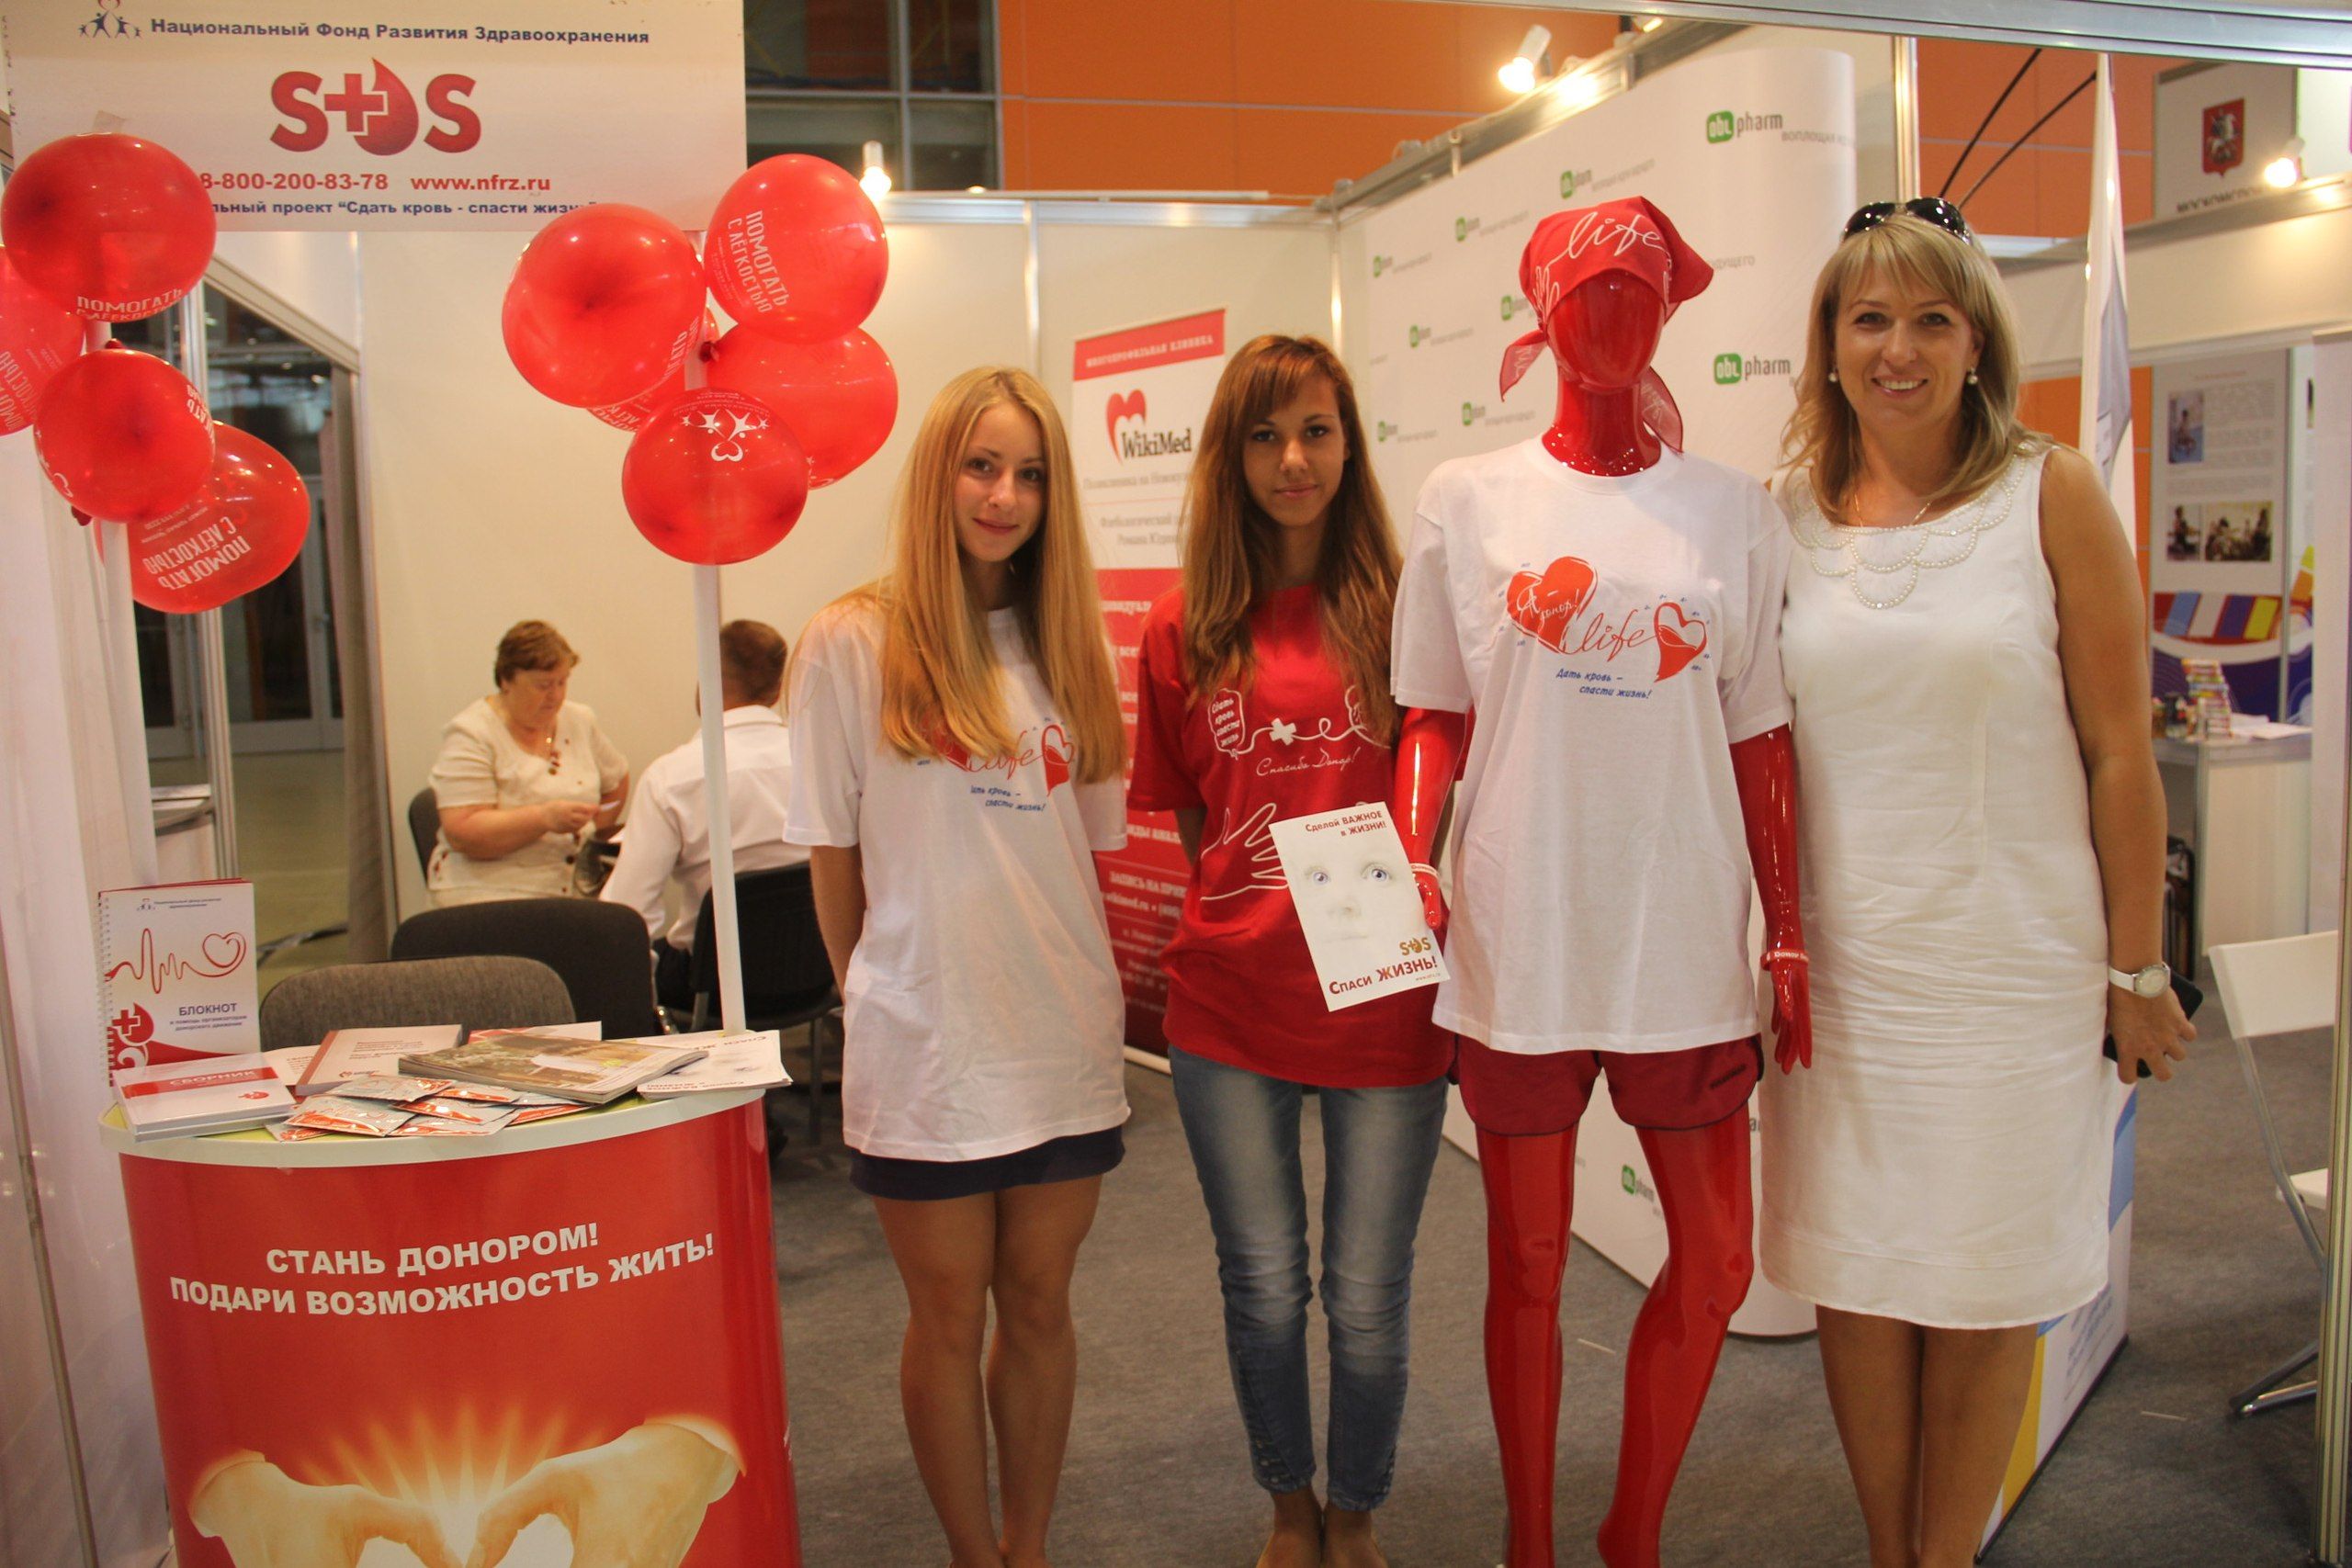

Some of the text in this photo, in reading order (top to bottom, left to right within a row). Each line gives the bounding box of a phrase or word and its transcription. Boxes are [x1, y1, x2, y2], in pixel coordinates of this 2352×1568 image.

[151, 18, 650, 44] Национальный Фонд Развития Здравоохранения
[199, 173, 551, 191] 8-800-200-83-78 www.nfrz.ru
[212, 201, 266, 213] льный
[273, 202, 333, 216] проект
[402, 203, 452, 216] кровь
[469, 203, 527, 213] спасти
[728, 217, 742, 230] С
[746, 209, 790, 306] ПОМОГАТЬ
[729, 231, 773, 312] ЛЁГКОСТЬЮ
[77, 289, 182, 313] ПОМОГАТЬ
[1122, 427, 1192, 458] WikiMed
[142, 524, 224, 575] ЛЁГКОСТЬЮ
[158, 535, 252, 590] ПОМОГАТЬ
[1566, 609, 1651, 662] life
[1555, 668, 1581, 679] Дать
[1584, 671, 1611, 682] кровь
[1579, 685, 1653, 699] спасти жизнь!
[1256, 746, 1362, 776] Спасибо Донор!
[1306, 810, 1383, 833] Сделай ВАЖНОЕ
[1350, 820, 1387, 835] ЖИЗНИ!
[1375, 955, 1438, 982] ЖИЗНЬ!
[178, 1002, 238, 1016] БЛОКНОТ
[266, 1223, 599, 1278] СТАНЬ ДОНОРОМ!
[170, 1233, 715, 1315] ПОДАРИ ВОЗМОЖНОСТЬ ЖИТЬ!
